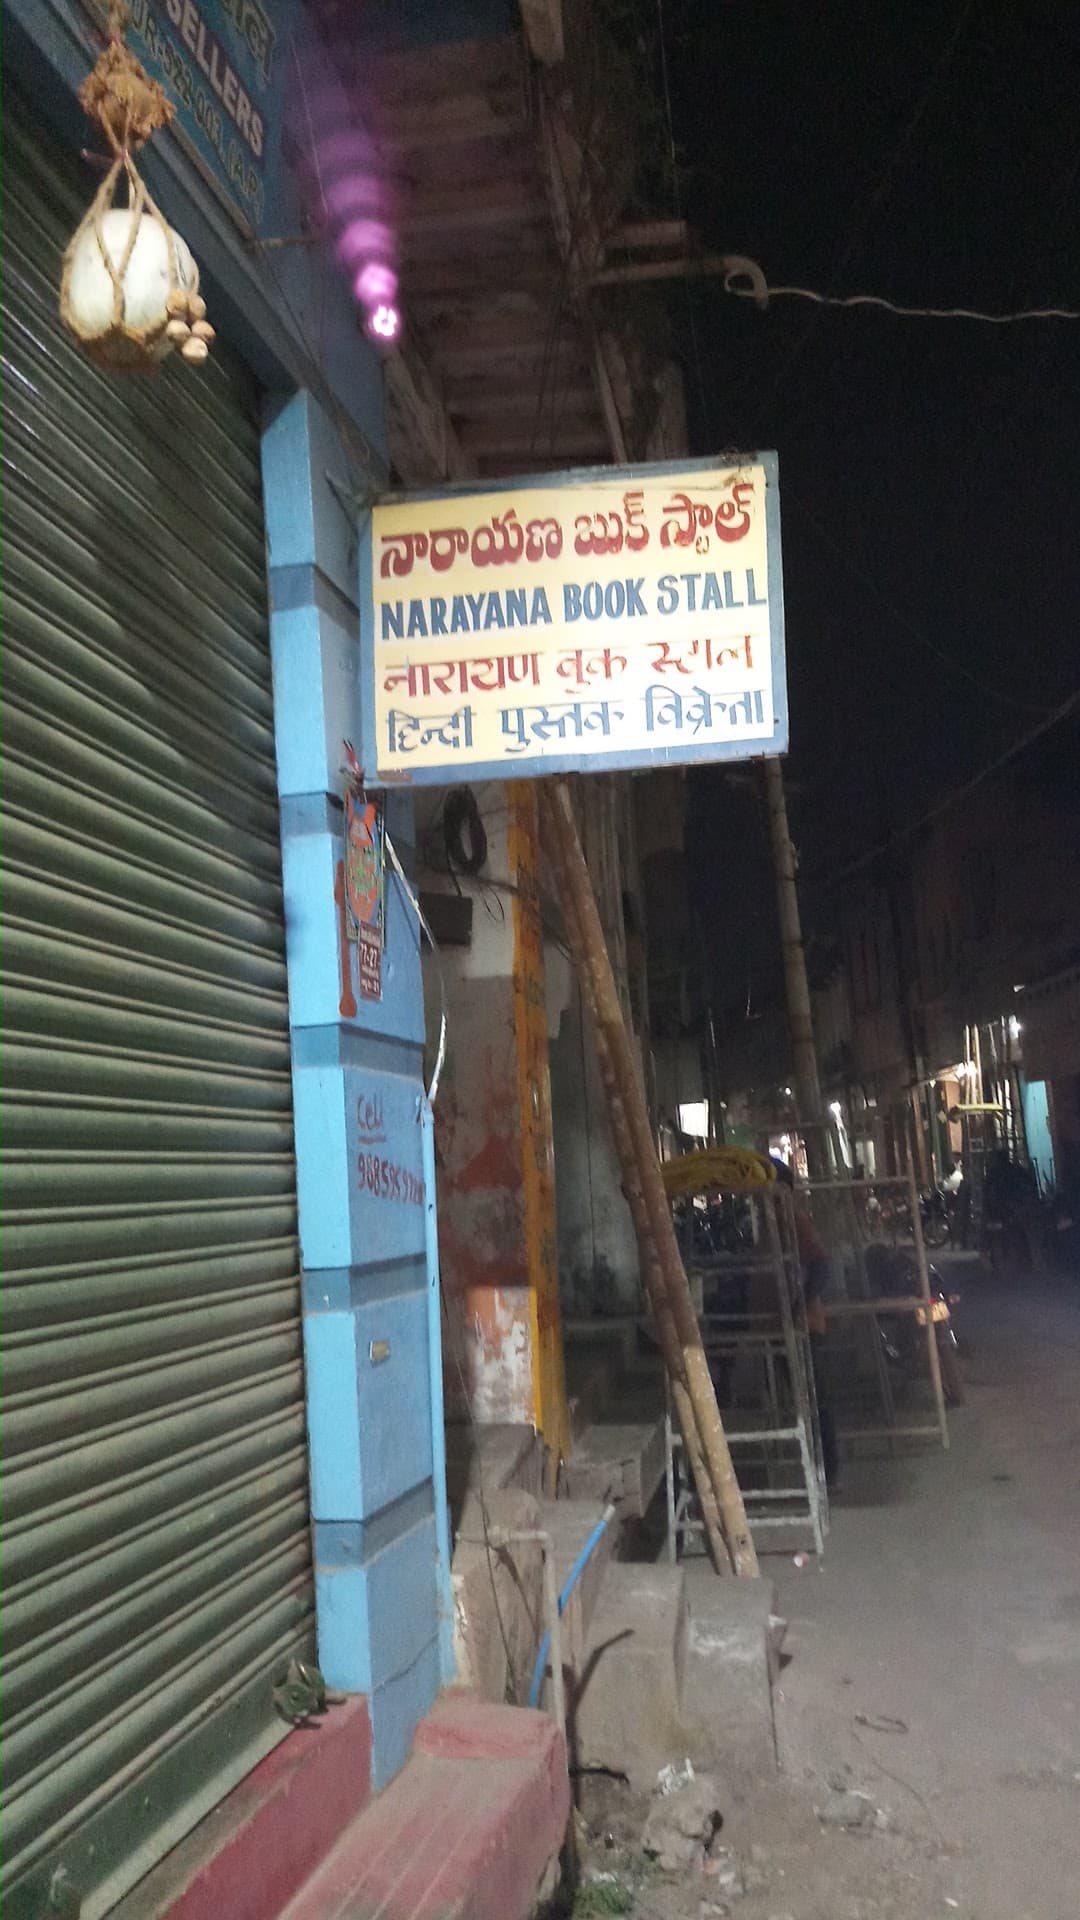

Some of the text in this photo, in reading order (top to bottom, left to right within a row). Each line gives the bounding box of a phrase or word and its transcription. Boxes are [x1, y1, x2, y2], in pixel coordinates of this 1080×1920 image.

[380, 483, 755, 579] నారాయణ బుక్ స్టాల్
[381, 568, 768, 641] NARAYANA BOOK STALL
[383, 652, 542, 697] नारायण
[386, 684, 766, 753] हिन्दी पुस्तक विक्रेता
